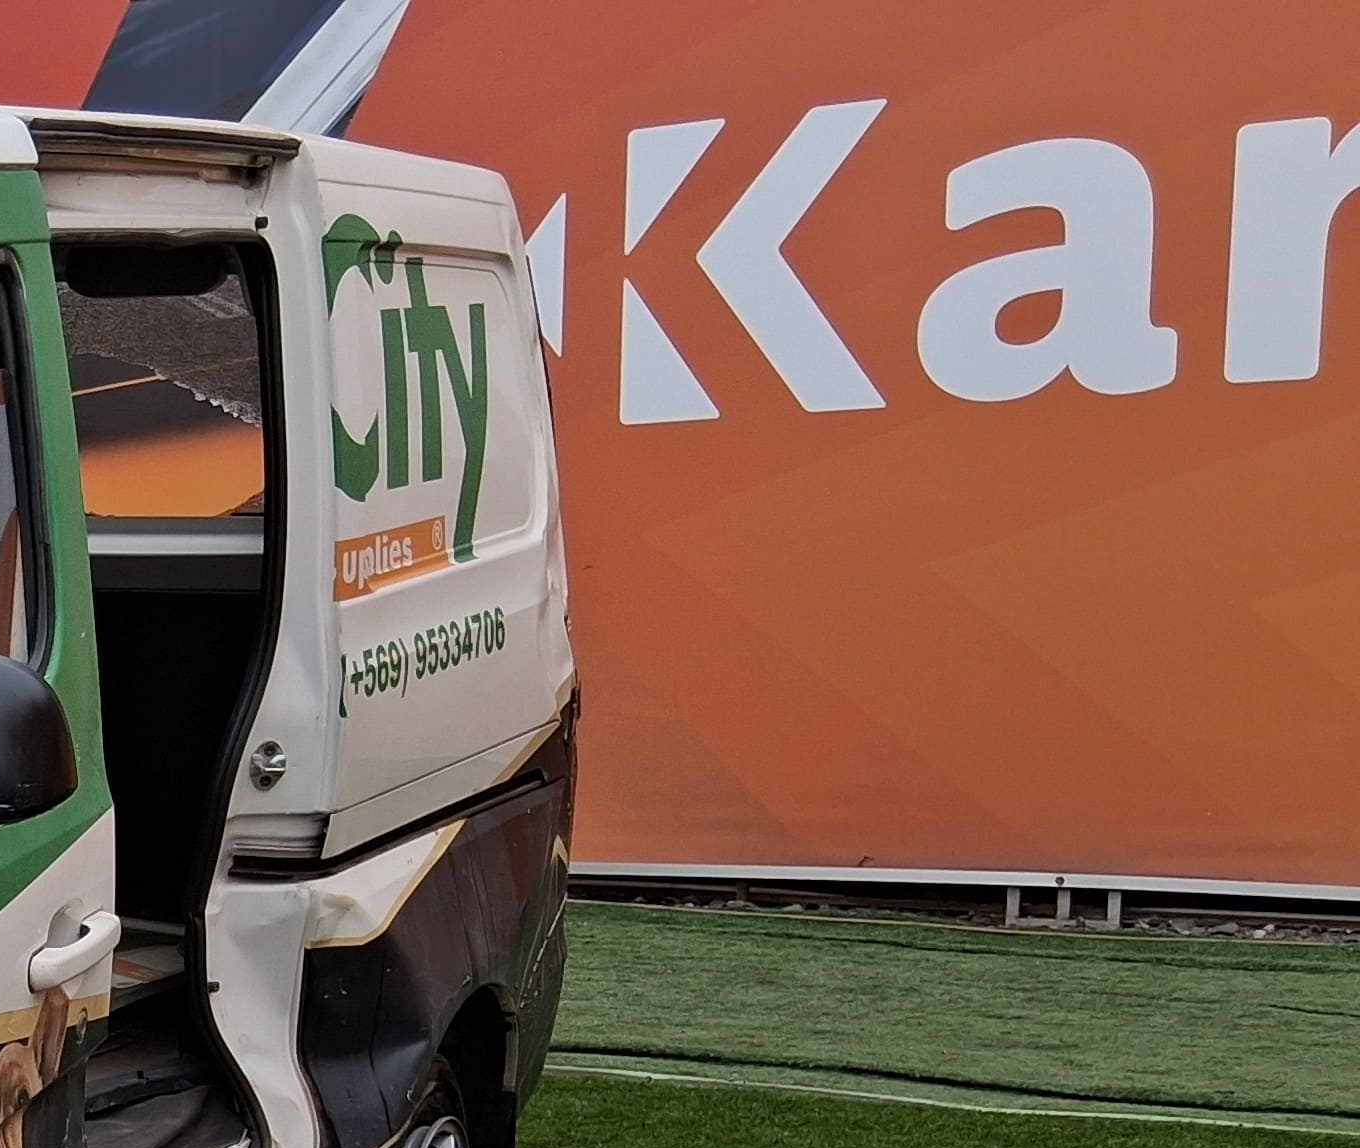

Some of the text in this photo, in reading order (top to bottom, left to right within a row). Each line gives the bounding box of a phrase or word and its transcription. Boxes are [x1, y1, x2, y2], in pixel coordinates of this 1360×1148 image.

[321, 213, 488, 564] City
[338, 607, 506, 718] (+569) 95334706
